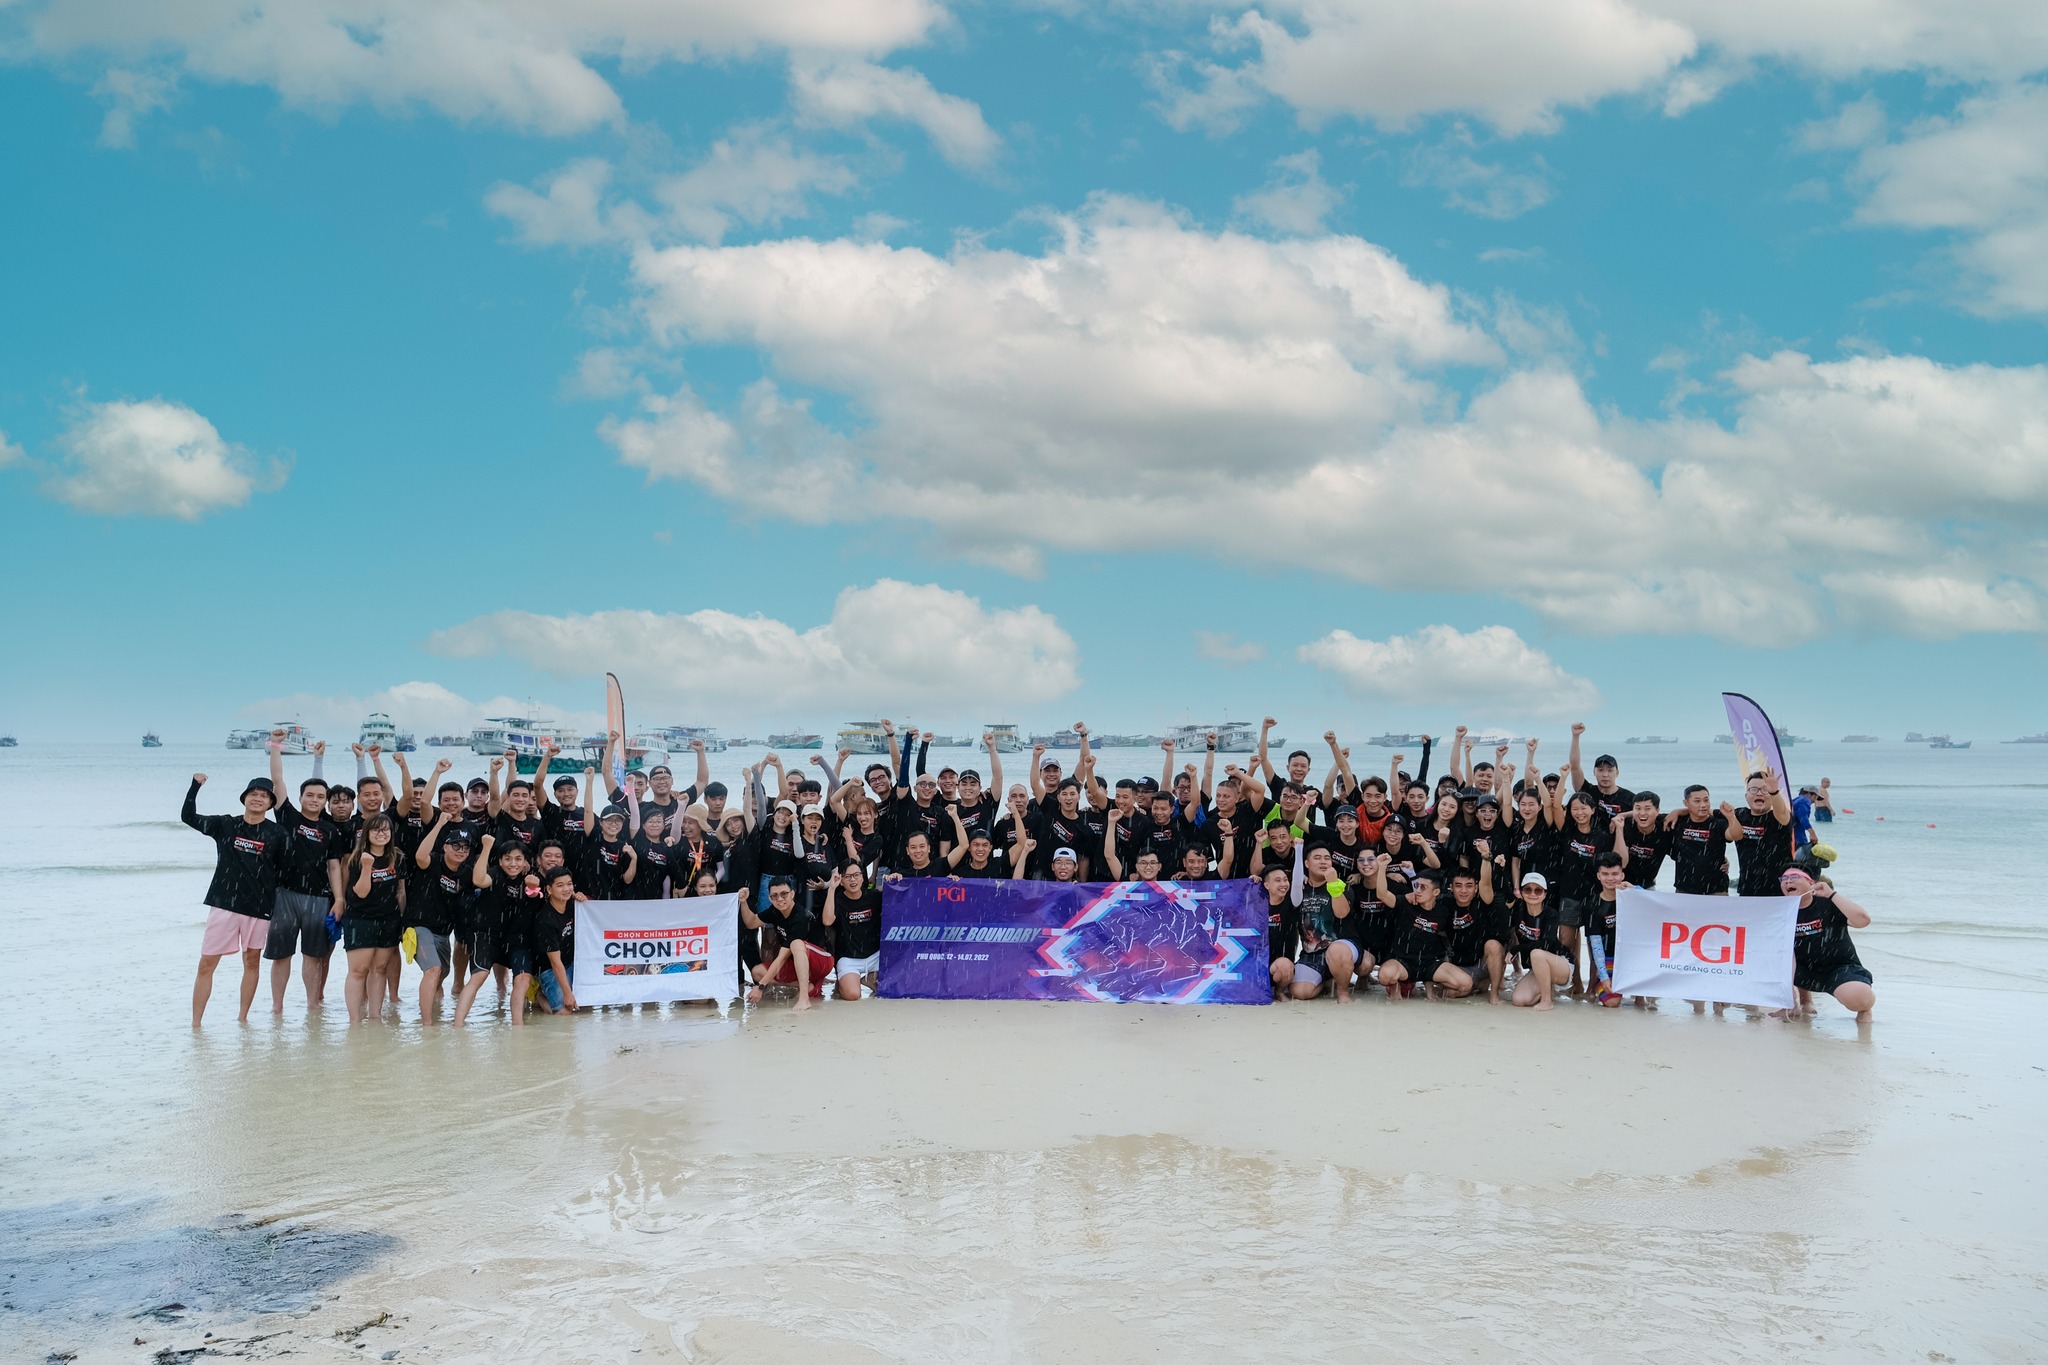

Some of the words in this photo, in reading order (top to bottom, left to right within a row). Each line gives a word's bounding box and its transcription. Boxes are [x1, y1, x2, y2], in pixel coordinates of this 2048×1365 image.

[937, 887, 966, 902] PGI
[643, 930, 669, 938] CHÍNH
[885, 925, 941, 941] BEYOND
[940, 926, 968, 941] THE
[965, 927, 1042, 943] BOUNDARY
[604, 941, 671, 963] CHỌN
[675, 938, 708, 957] PGI
[1660, 921, 1746, 965] PGI
[1683, 965, 1709, 973] GIANG
